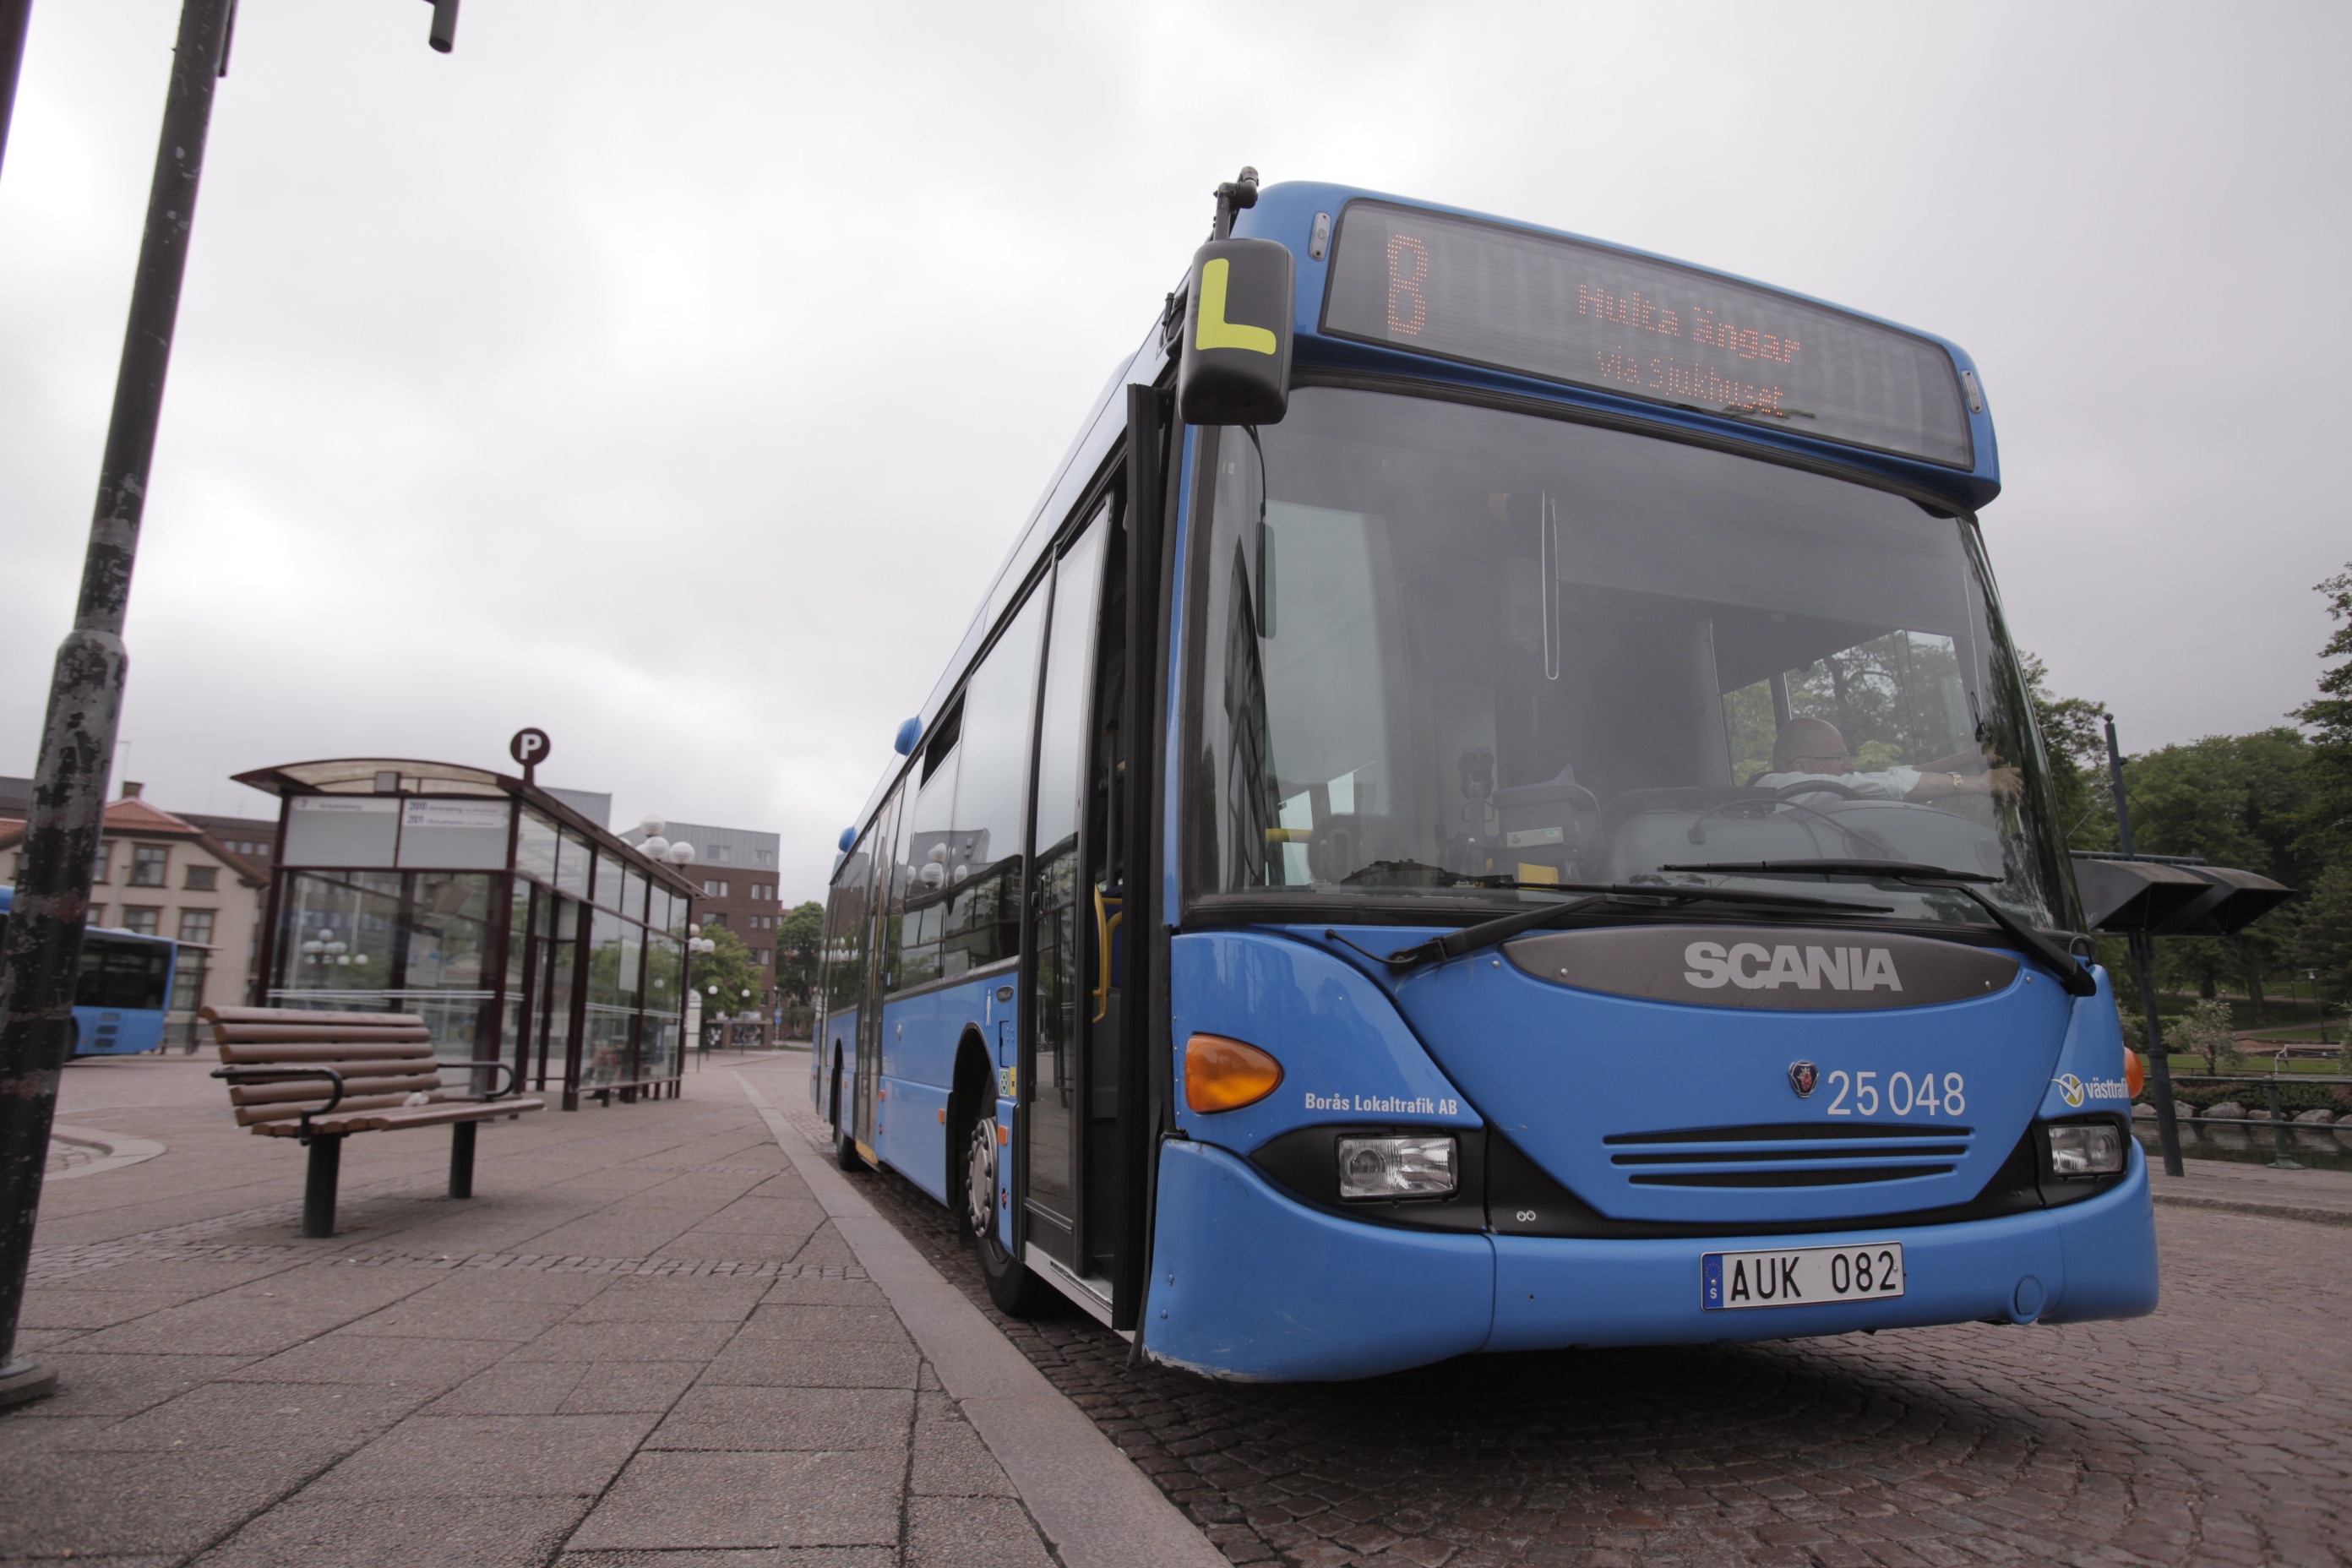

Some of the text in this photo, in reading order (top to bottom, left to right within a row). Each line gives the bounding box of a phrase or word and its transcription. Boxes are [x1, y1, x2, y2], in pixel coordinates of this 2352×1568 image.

[1579, 284, 1800, 363] Hulta ängar
[1598, 345, 1640, 384] via
[520, 733, 542, 760] P
[1684, 941, 1903, 992] SCANIA
[1305, 1092, 1457, 1115] Borås Lokaltrafik AB
[1710, 1288, 1718, 1299] S
[1730, 1250, 1897, 1301] AUK 082
